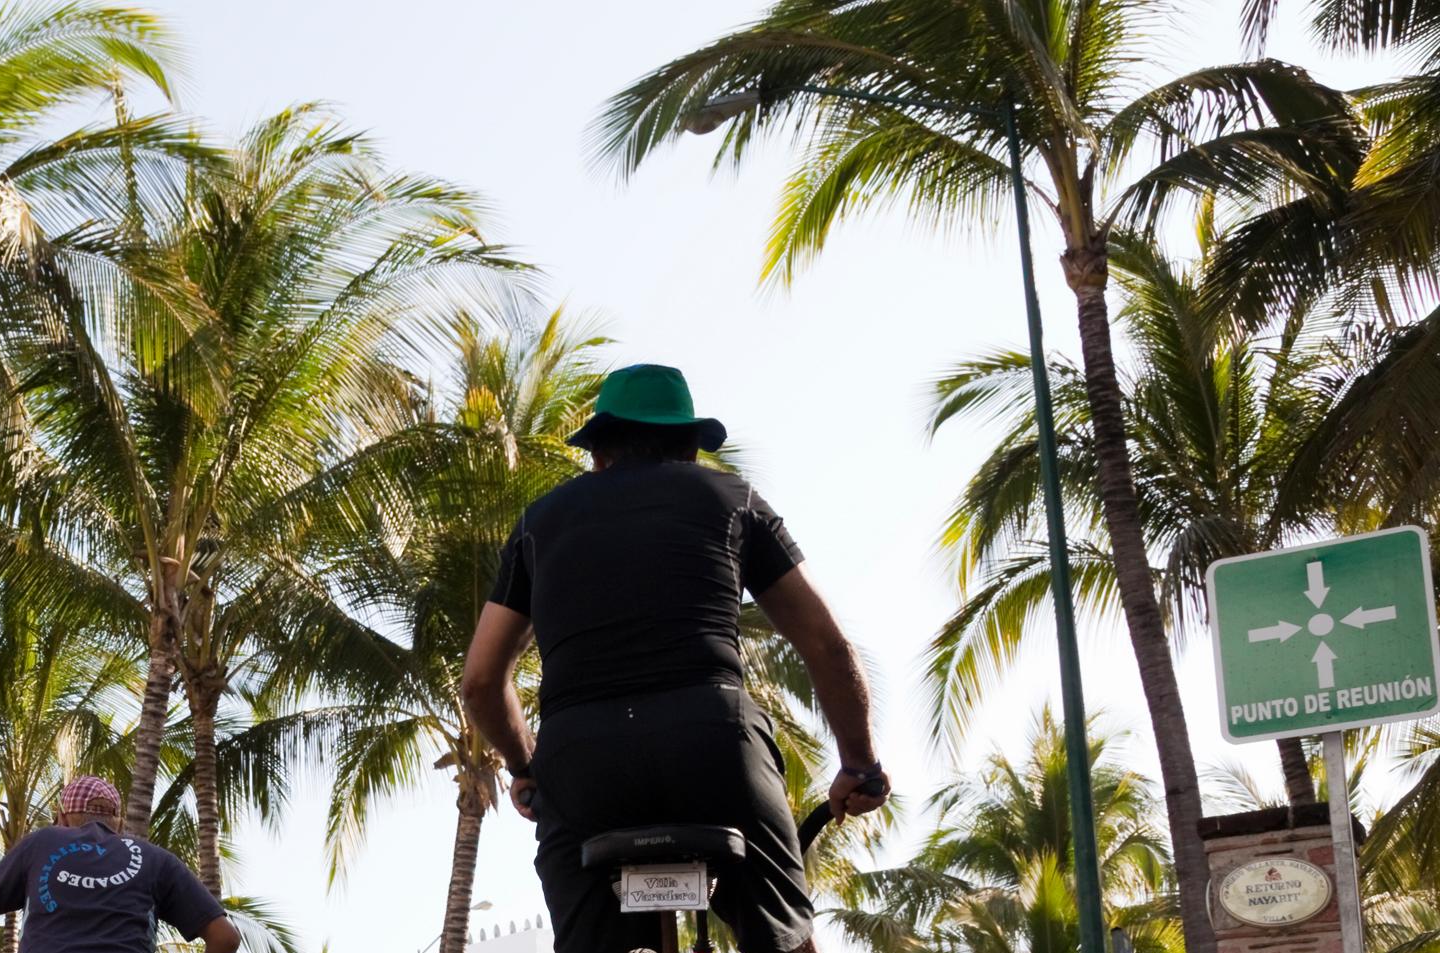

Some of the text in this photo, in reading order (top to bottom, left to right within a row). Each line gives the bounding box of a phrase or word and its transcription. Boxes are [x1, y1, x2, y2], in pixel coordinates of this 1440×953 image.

[1231, 675, 1432, 725] PUNTO DE REUNIÓN
[57, 838, 143, 888] ACTIVIDADES
[39, 843, 107, 912] ACTIVITIES
[644, 877, 679, 889] Villa
[1246, 880, 1302, 894] RETORNO
[630, 890, 697, 903] Varadero
[1248, 893, 1301, 907] NAYARIT
